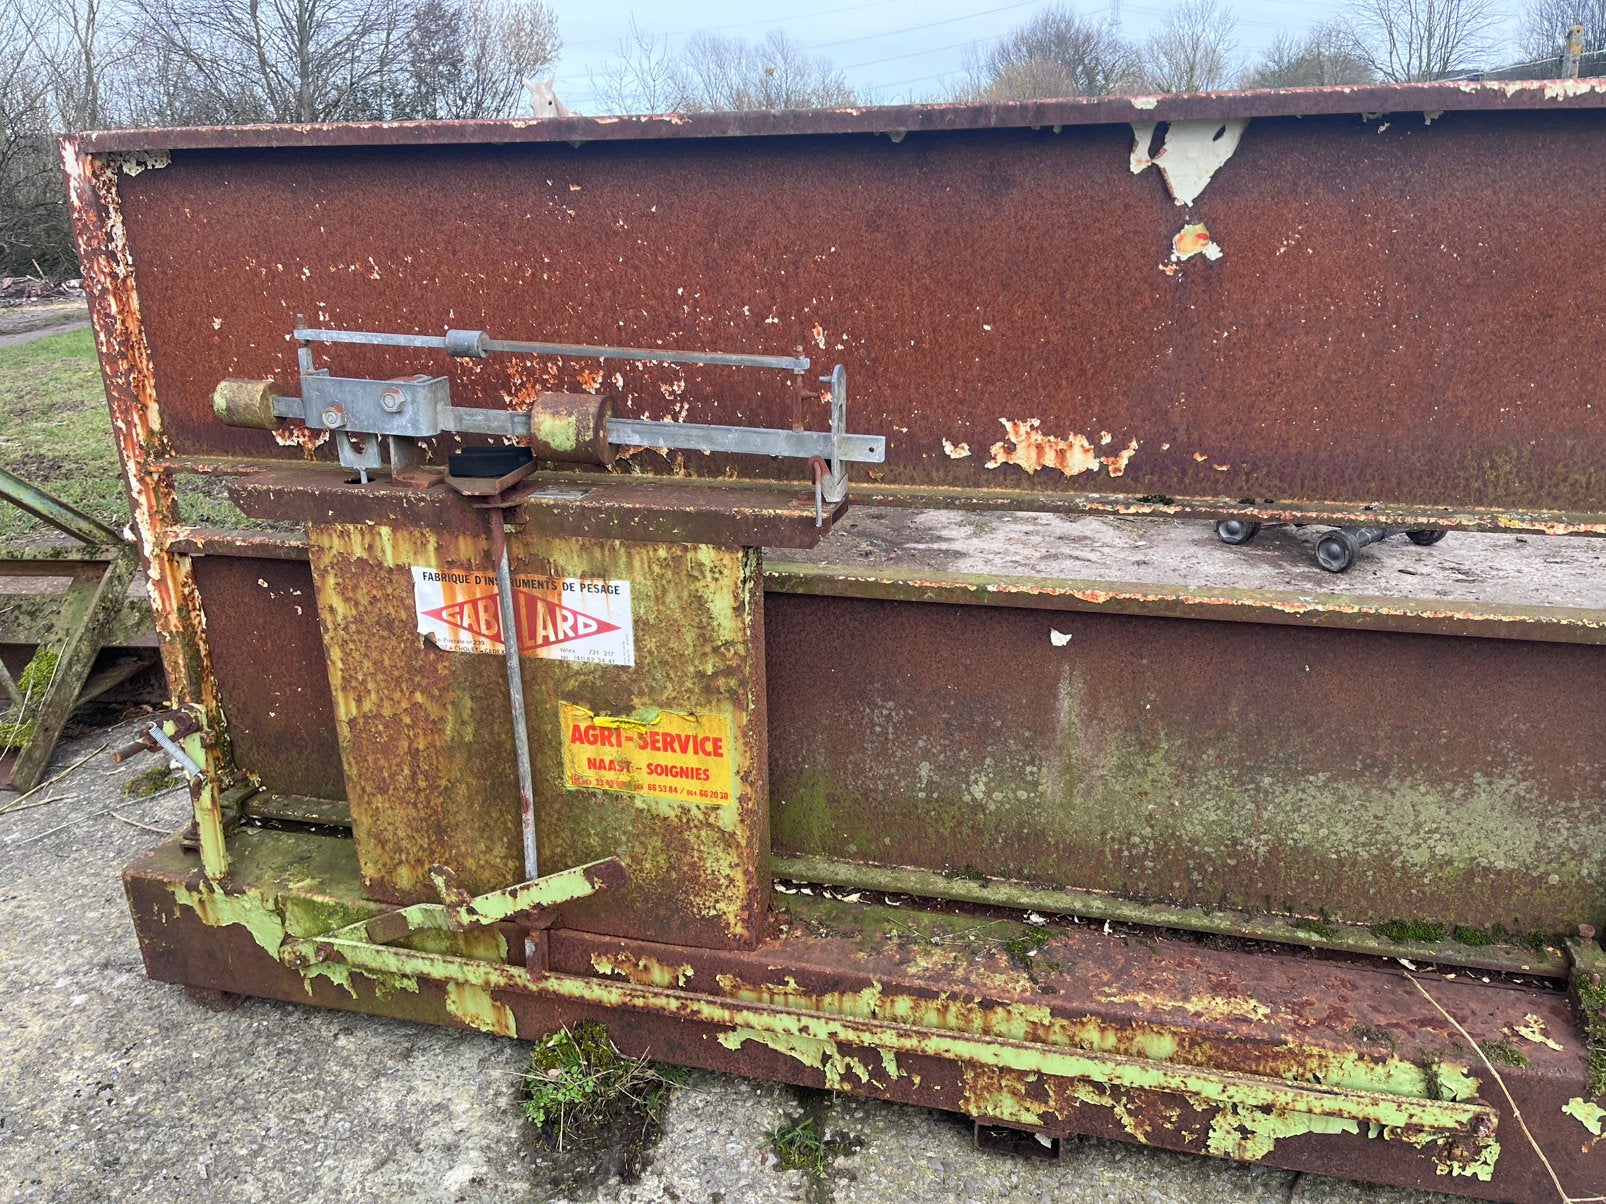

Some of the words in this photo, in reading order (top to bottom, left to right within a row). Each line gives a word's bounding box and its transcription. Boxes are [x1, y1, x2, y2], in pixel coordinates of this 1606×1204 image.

[422, 571, 471, 585] FABRIQUE
[562, 581, 576, 592] DE
[580, 583, 621, 595] PESAGE
[441, 593, 598, 648] GABLARD
[587, 757, 632, 774] NAAST
[646, 763, 711, 782] SOIGNIES
